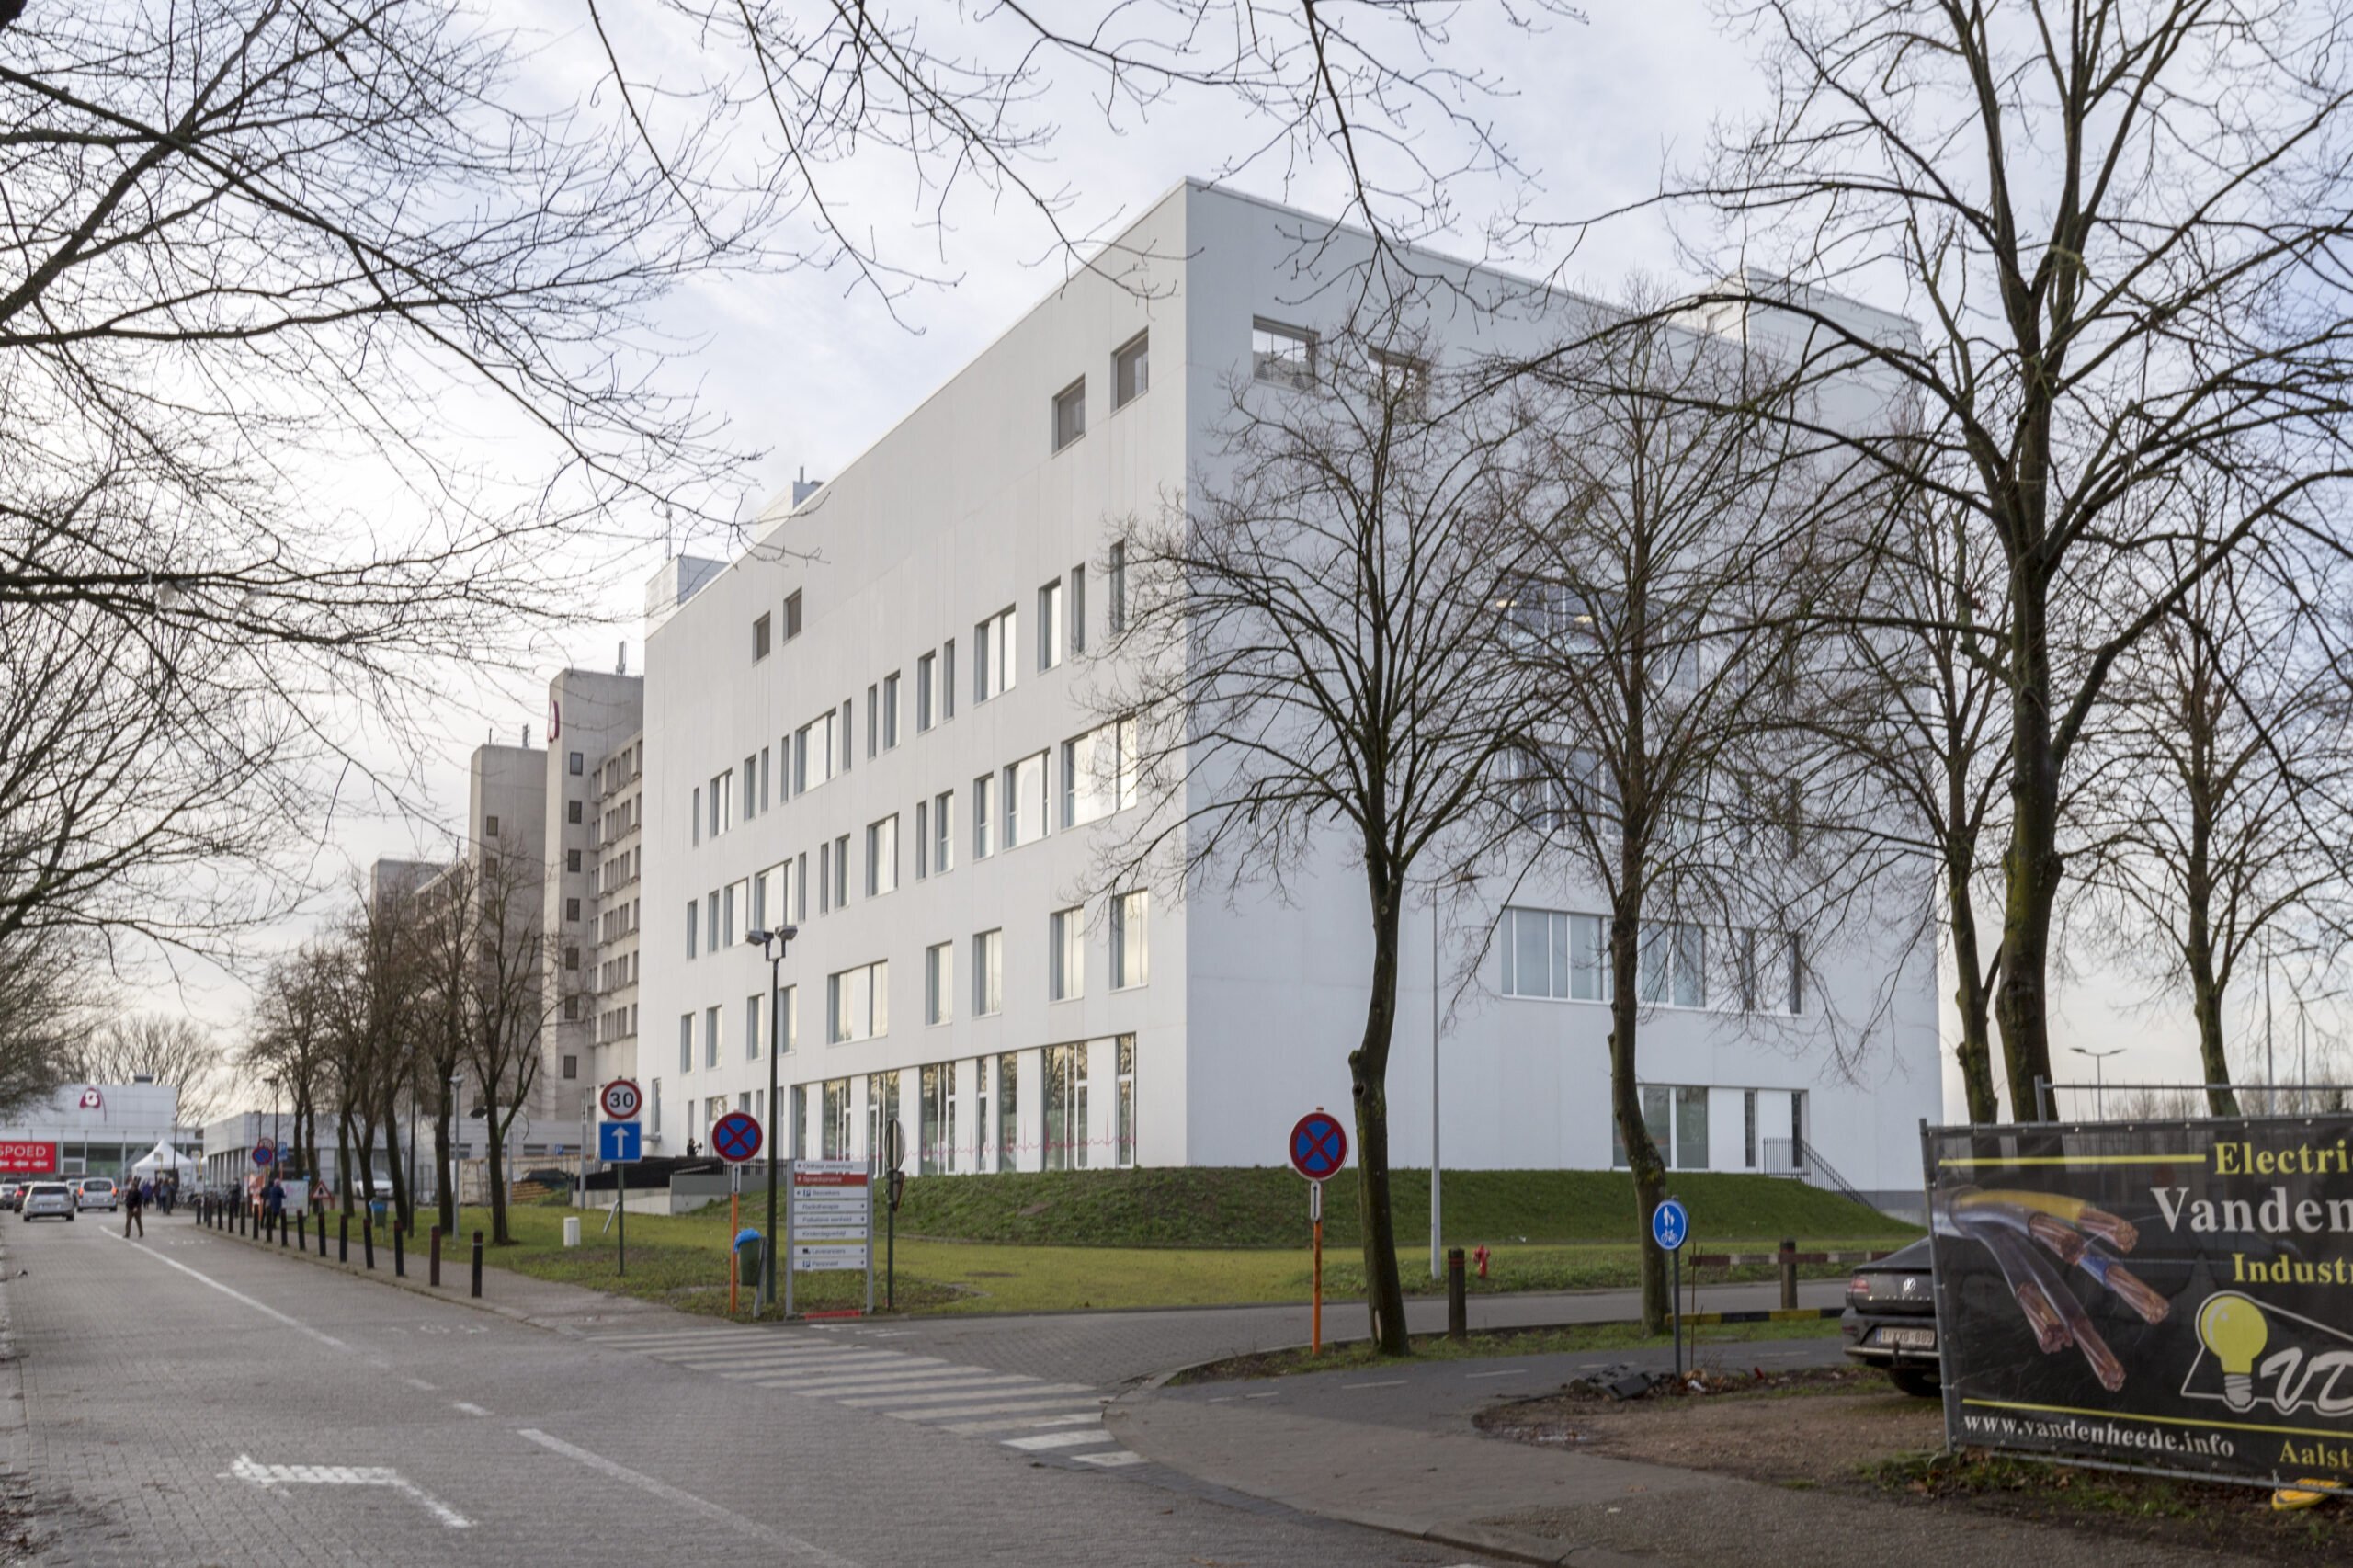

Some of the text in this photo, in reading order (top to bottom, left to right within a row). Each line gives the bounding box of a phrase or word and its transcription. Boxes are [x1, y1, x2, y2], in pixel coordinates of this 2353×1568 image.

[609, 1091, 634, 1108] 30
[2213, 1139, 2353, 1175] Electri
[2150, 1186, 2353, 1233] Vanden
[2232, 1253, 2353, 1285] Indust
[1964, 1415, 2234, 1458] www.vandenheede.info
[2279, 1440, 2352, 1468] Aalst
